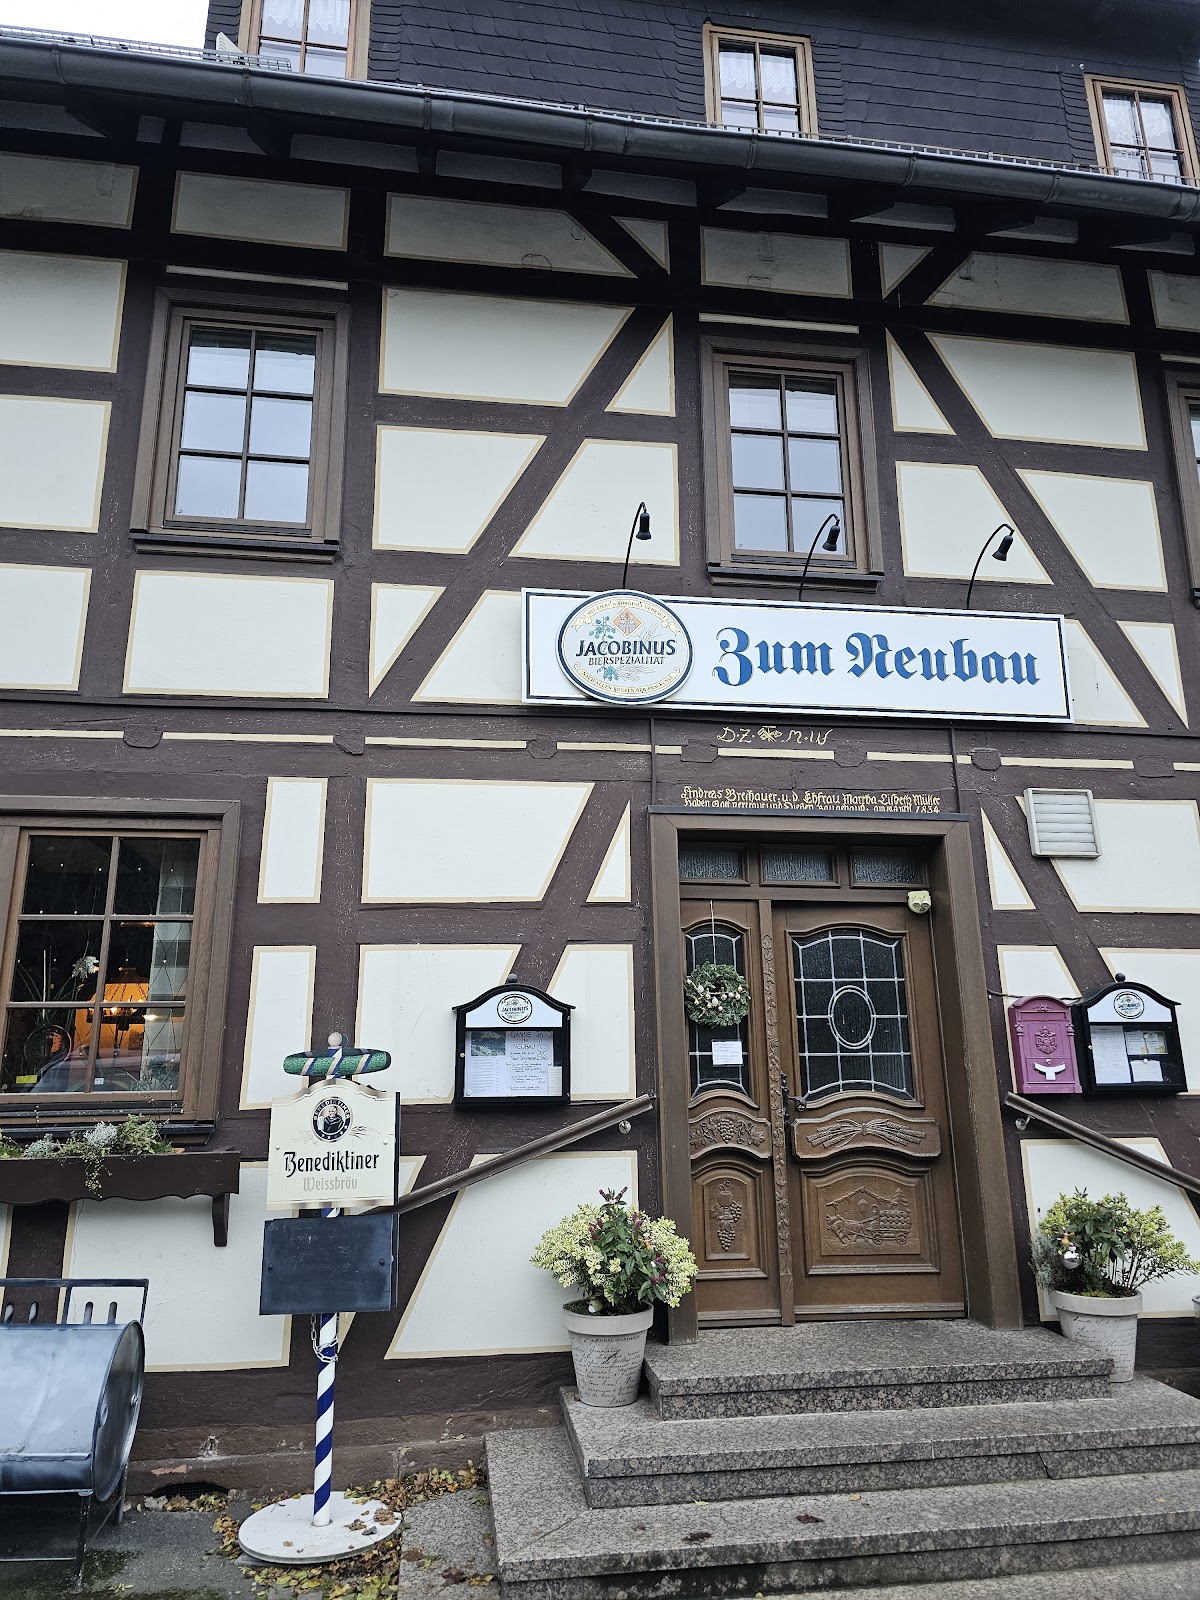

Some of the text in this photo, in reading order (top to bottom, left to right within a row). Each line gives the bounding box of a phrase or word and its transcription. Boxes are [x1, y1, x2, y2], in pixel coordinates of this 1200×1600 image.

[575, 639, 676, 657] JACOBINUS
[711, 627, 1041, 687] Zum Neubau
[681, 785, 723, 799] Andreas
[283, 1151, 380, 1178] Benediktiner
[303, 1176, 358, 1193] Weissbräu
